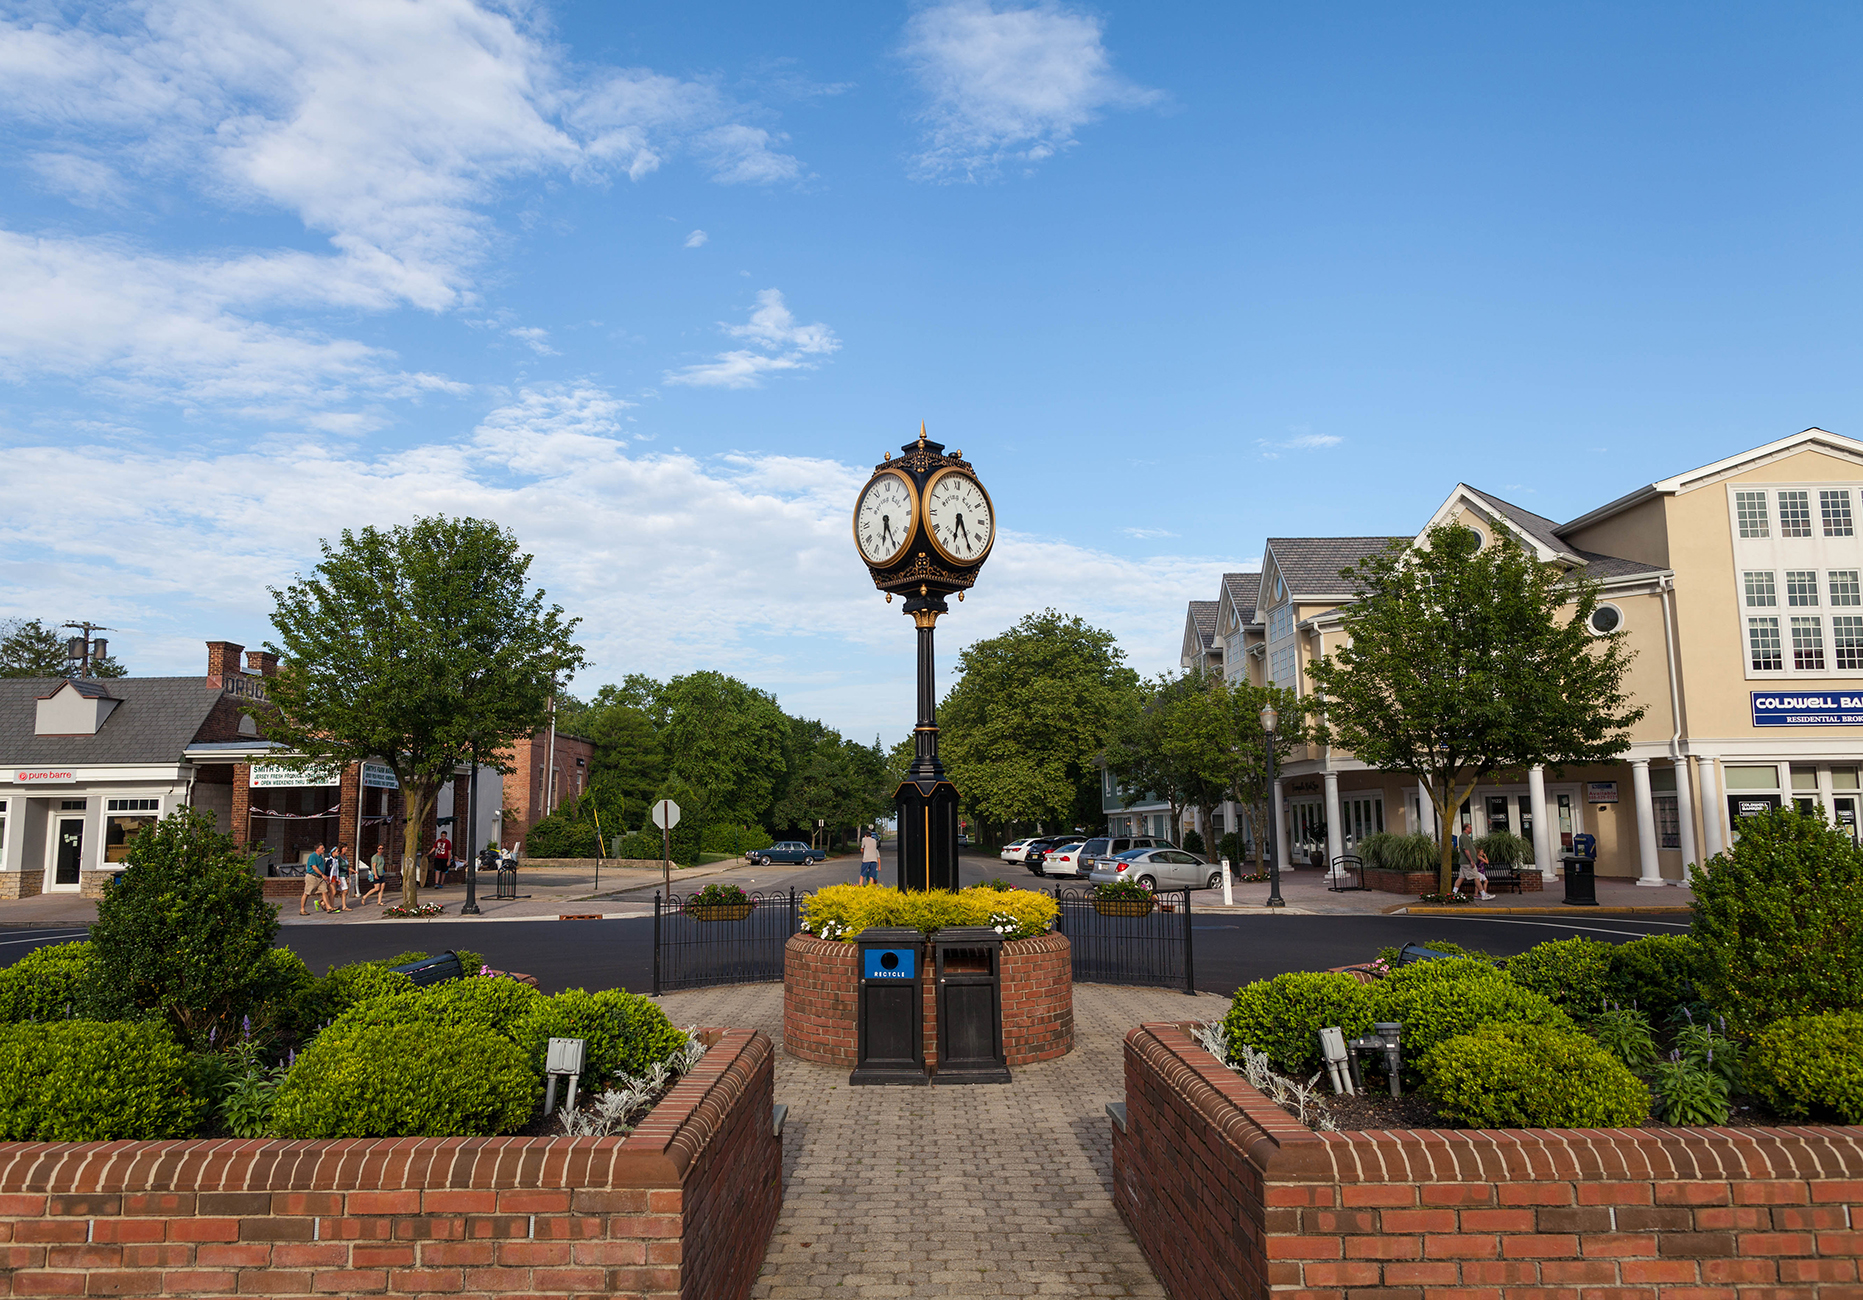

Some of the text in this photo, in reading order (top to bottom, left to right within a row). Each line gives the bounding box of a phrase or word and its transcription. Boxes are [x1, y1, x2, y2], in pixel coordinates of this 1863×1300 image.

[942, 494, 973, 513] Spring Lake
[1756, 697, 1863, 709] COLDWELL BA
[28, 771, 72, 780] pure barre
